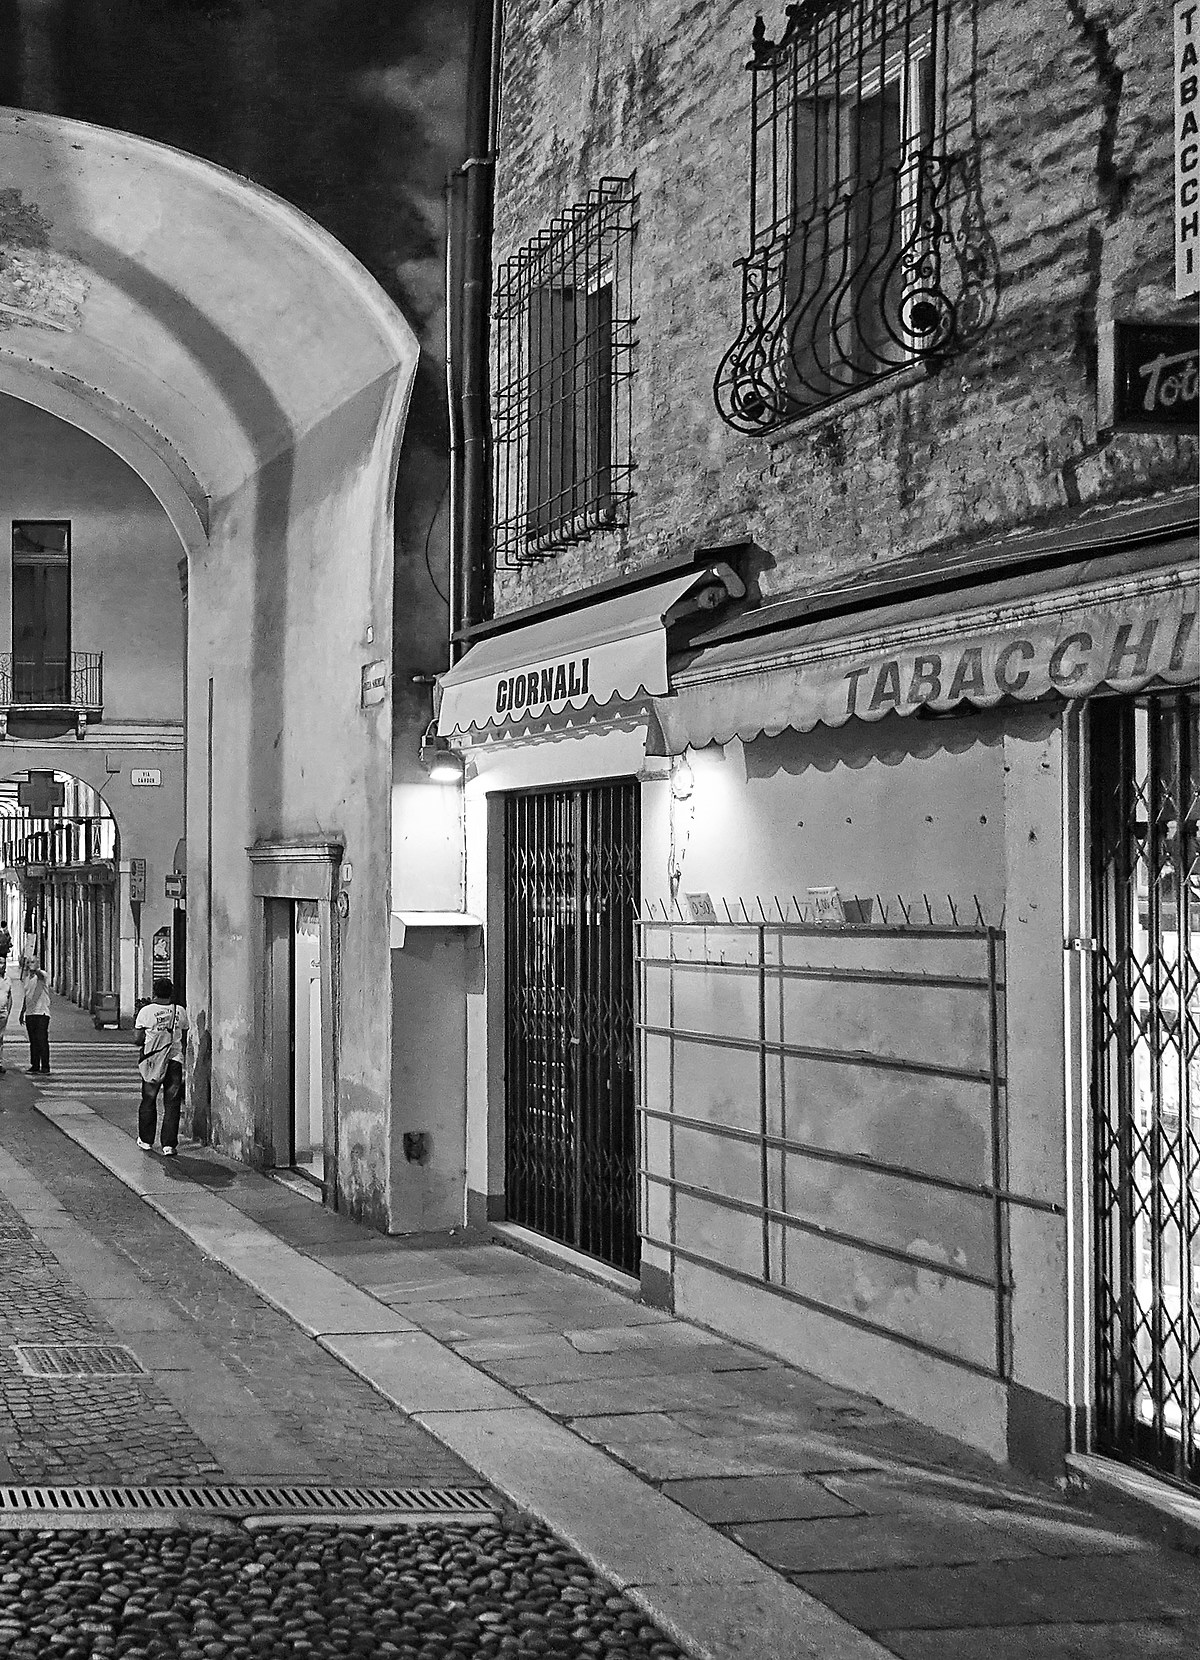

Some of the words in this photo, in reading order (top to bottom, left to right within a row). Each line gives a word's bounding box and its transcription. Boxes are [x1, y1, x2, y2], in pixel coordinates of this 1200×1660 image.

[1180, 6, 1198, 274] TABACCHI
[1139, 349, 1199, 411] Tot
[496, 657, 590, 714] GIORNALI
[843, 613, 1195, 715] TABACCHI
